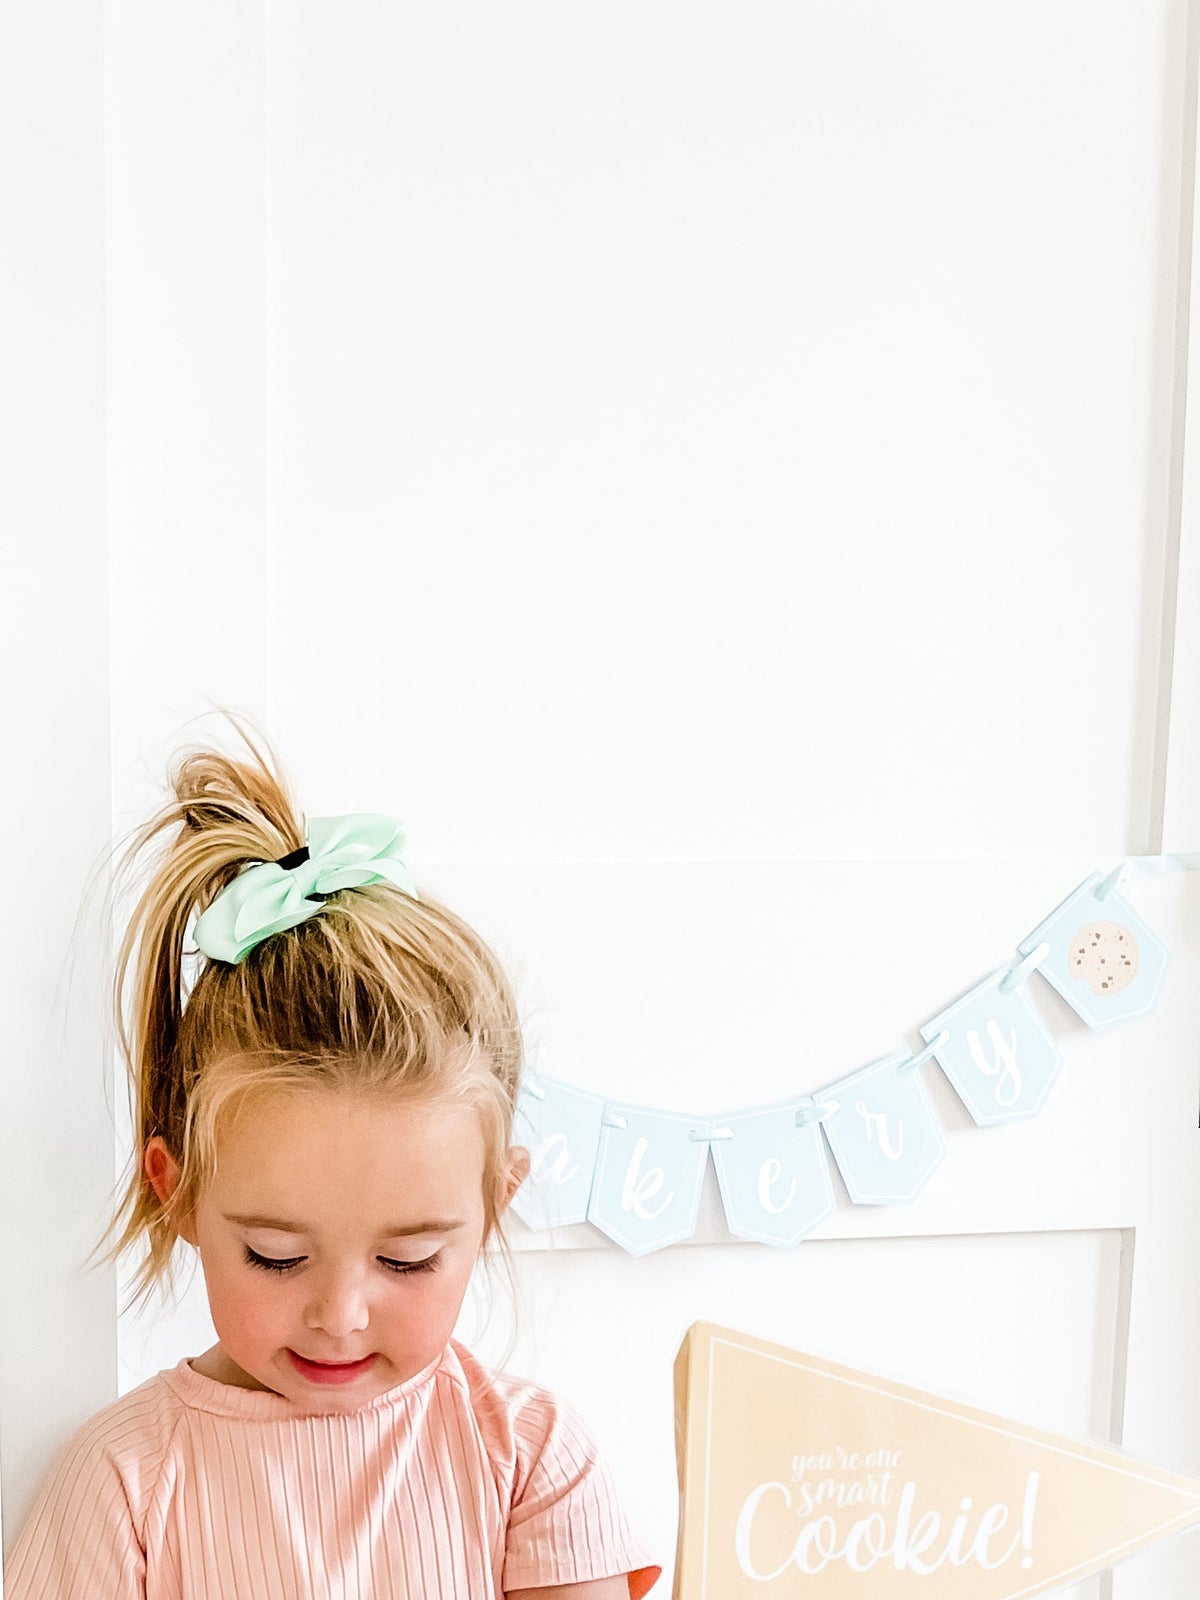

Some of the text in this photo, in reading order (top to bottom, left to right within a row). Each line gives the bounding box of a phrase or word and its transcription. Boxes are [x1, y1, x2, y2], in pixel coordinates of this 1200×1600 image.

[533, 1018, 1019, 1220] akery
[735, 1472, 1039, 1581] Cookie!
[798, 1472, 894, 1517] smart
